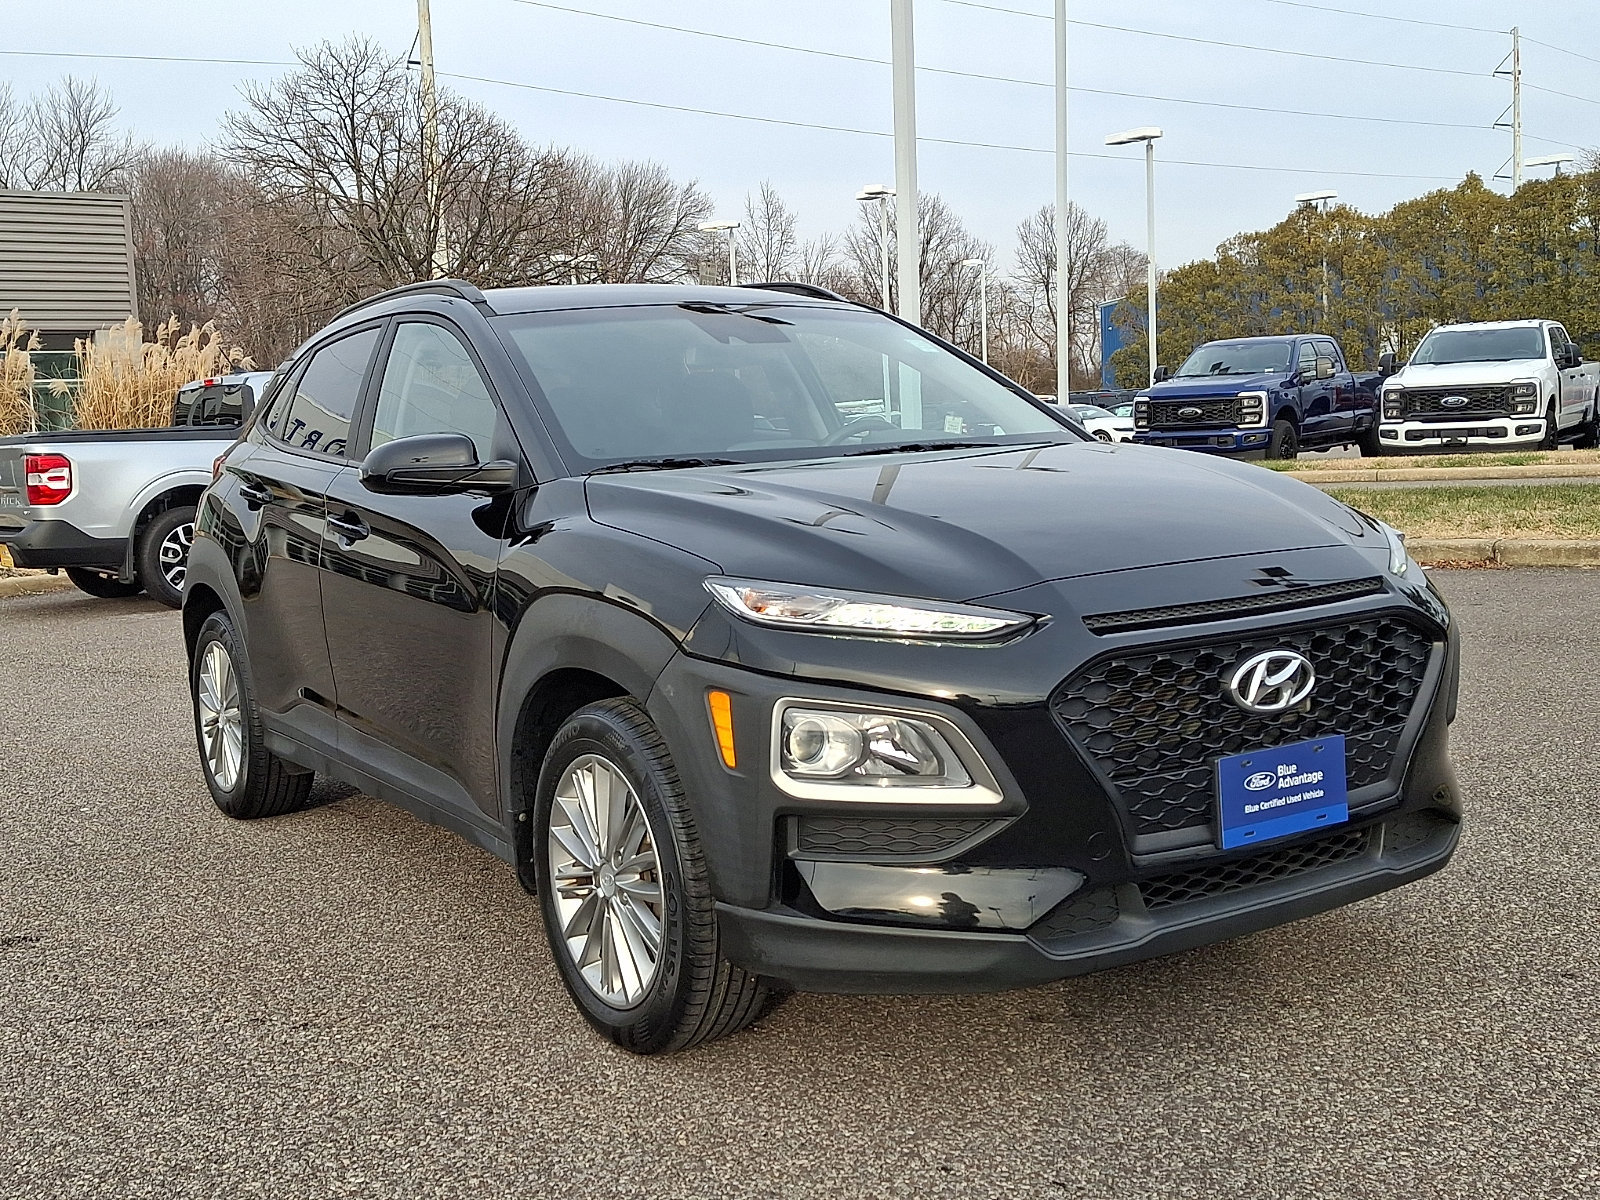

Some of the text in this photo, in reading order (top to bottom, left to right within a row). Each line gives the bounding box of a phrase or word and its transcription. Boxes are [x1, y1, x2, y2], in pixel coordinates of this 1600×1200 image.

[1277, 764, 1297, 776] Blue
[1248, 774, 1272, 789] Ford
[1277, 771, 1323, 789] Advantage
[1244, 789, 1324, 814] Blue Certified Used Vehicle
